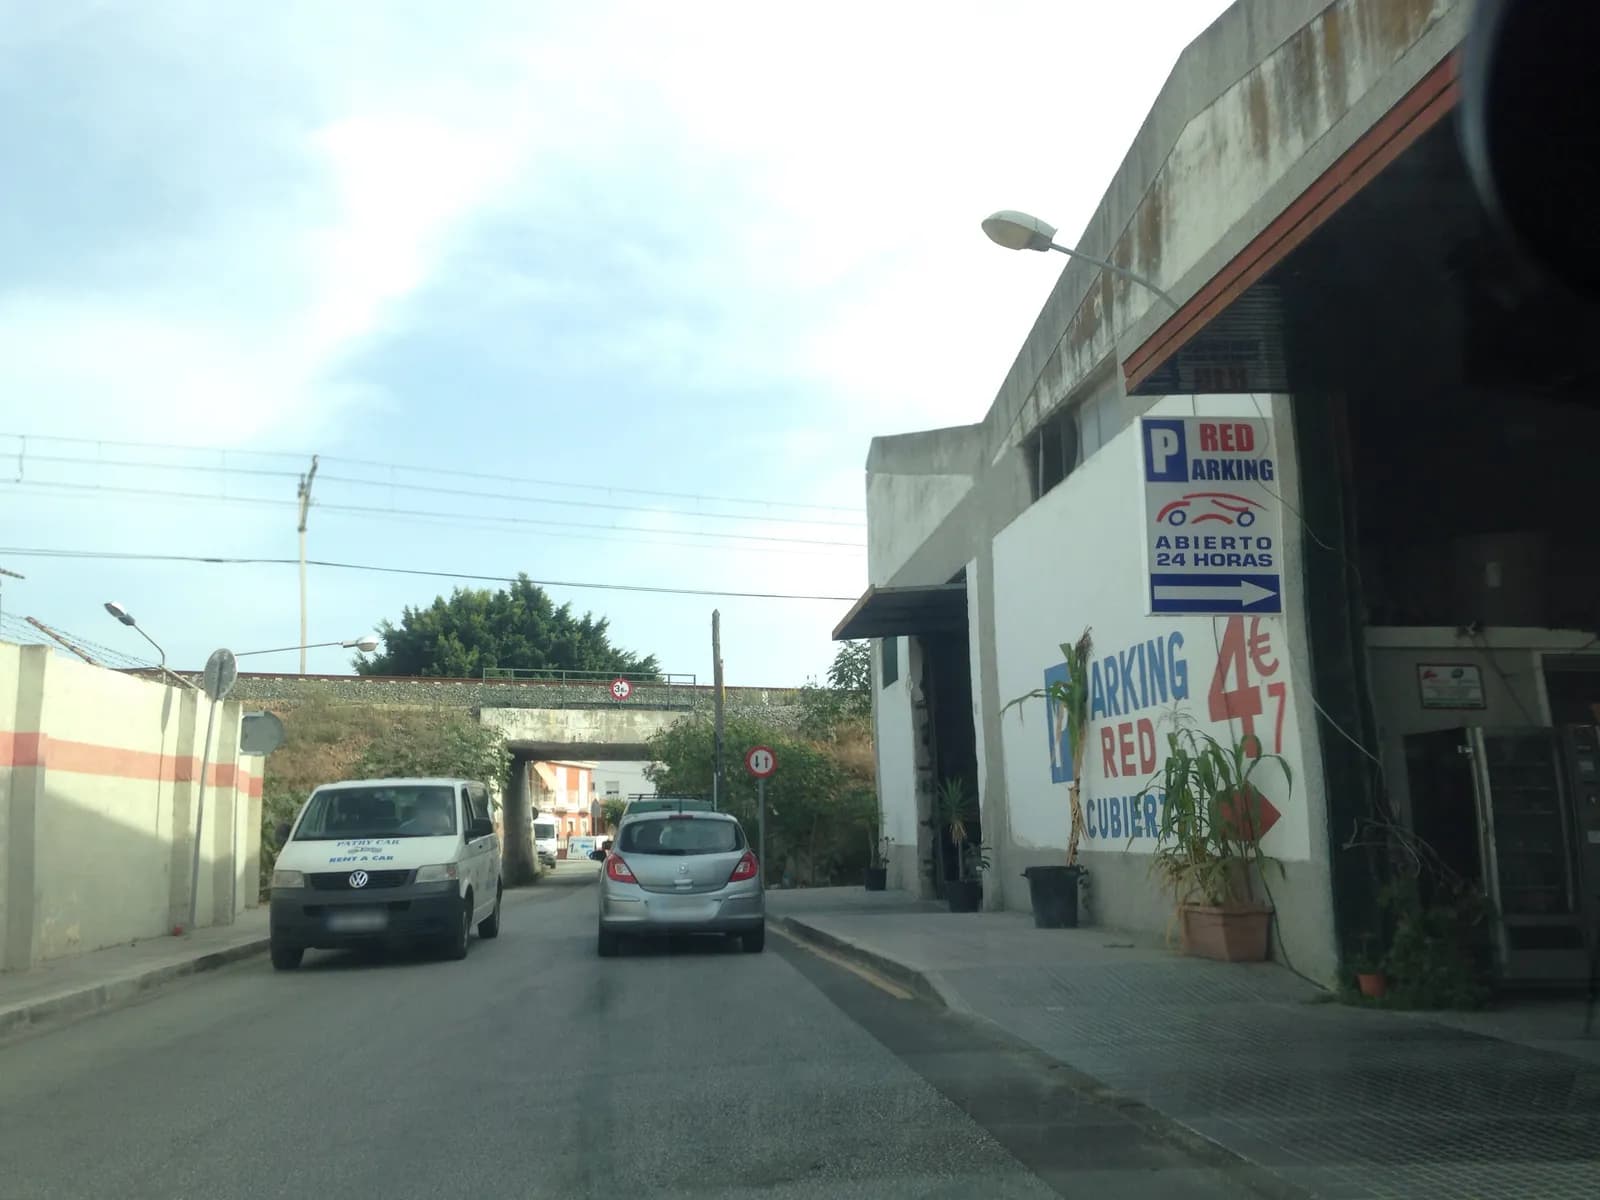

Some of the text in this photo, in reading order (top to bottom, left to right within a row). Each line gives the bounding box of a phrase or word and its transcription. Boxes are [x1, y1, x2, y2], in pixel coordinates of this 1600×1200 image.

[1150, 428, 1179, 473] P
[1199, 423, 1255, 453] RED
[1192, 459, 1274, 481] ARKING
[1156, 536, 1272, 550] ABIERTO
[1157, 553, 1273, 567] 24 HORAS
[1091, 631, 1189, 721] ARKING
[1101, 718, 1157, 778] RED
